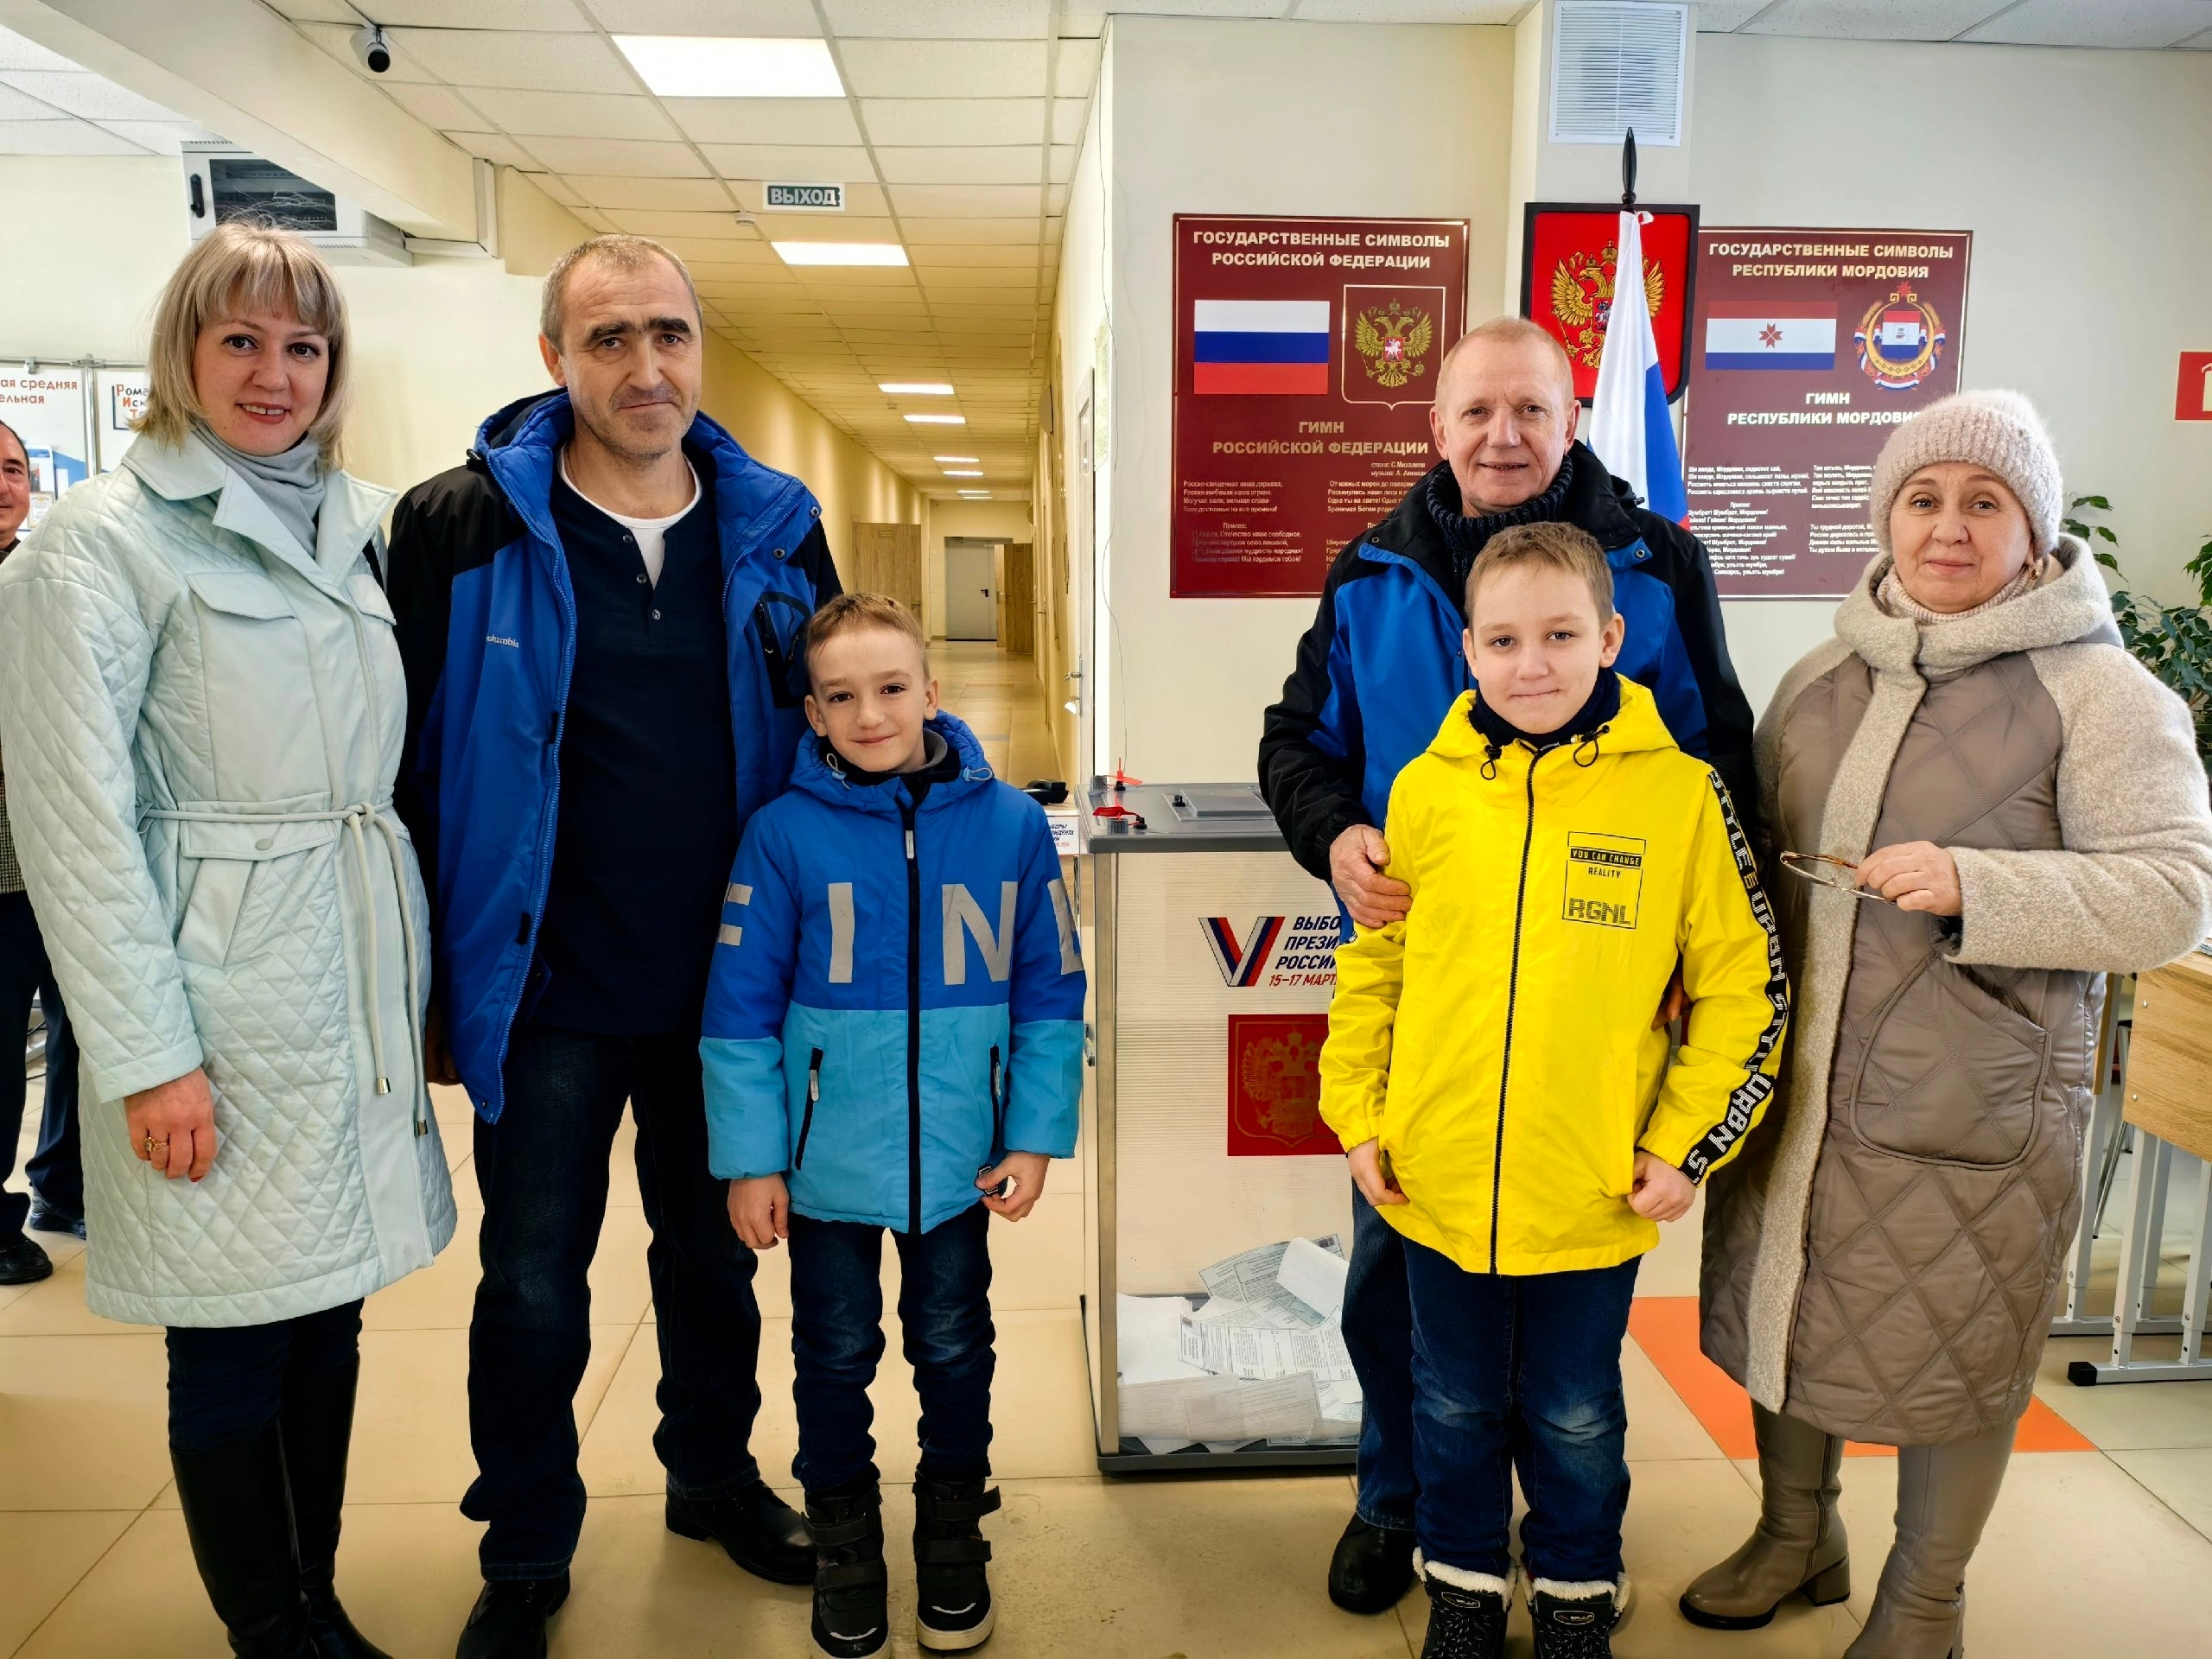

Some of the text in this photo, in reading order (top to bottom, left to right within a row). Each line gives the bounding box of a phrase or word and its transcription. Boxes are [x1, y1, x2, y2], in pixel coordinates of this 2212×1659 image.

[771, 188, 836, 205] ВЫХОД
[1193, 231, 1450, 248] ГОСУДАРСТВЕННЫЕ СИМВОЛЫ
[1709, 243, 1953, 258] ГОСУДАРСТВЕННЫЕ СИМВОЛЫ
[1212, 251, 1430, 270] РОССИЙСКОЙ ФЕДЕРАЦИИ
[1732, 264, 1929, 279] РЕСПУБЛИКИ МОРДОВИЯ
[20, 378, 79, 391] средняя
[1805, 392, 1850, 404] ГИМН
[1727, 412, 1832, 425] РЕСПУБЛИКИ
[1299, 421, 1344, 434] ГИМН
[1212, 439, 1428, 455] РОССИЙСКОЙ ФЕДЕРАЦИИ
[1573, 849, 1639, 866] YOU CAN CHANGE
[1588, 867, 1621, 879] REALITY
[1569, 898, 1631, 925] RGNL
[1293, 916, 1341, 931] ВЫБО
[1283, 936, 1339, 950] ПРЕЗИ
[1302, 974, 1337, 986] МАРТ
[1708, 1072, 1771, 1154] URBAN
